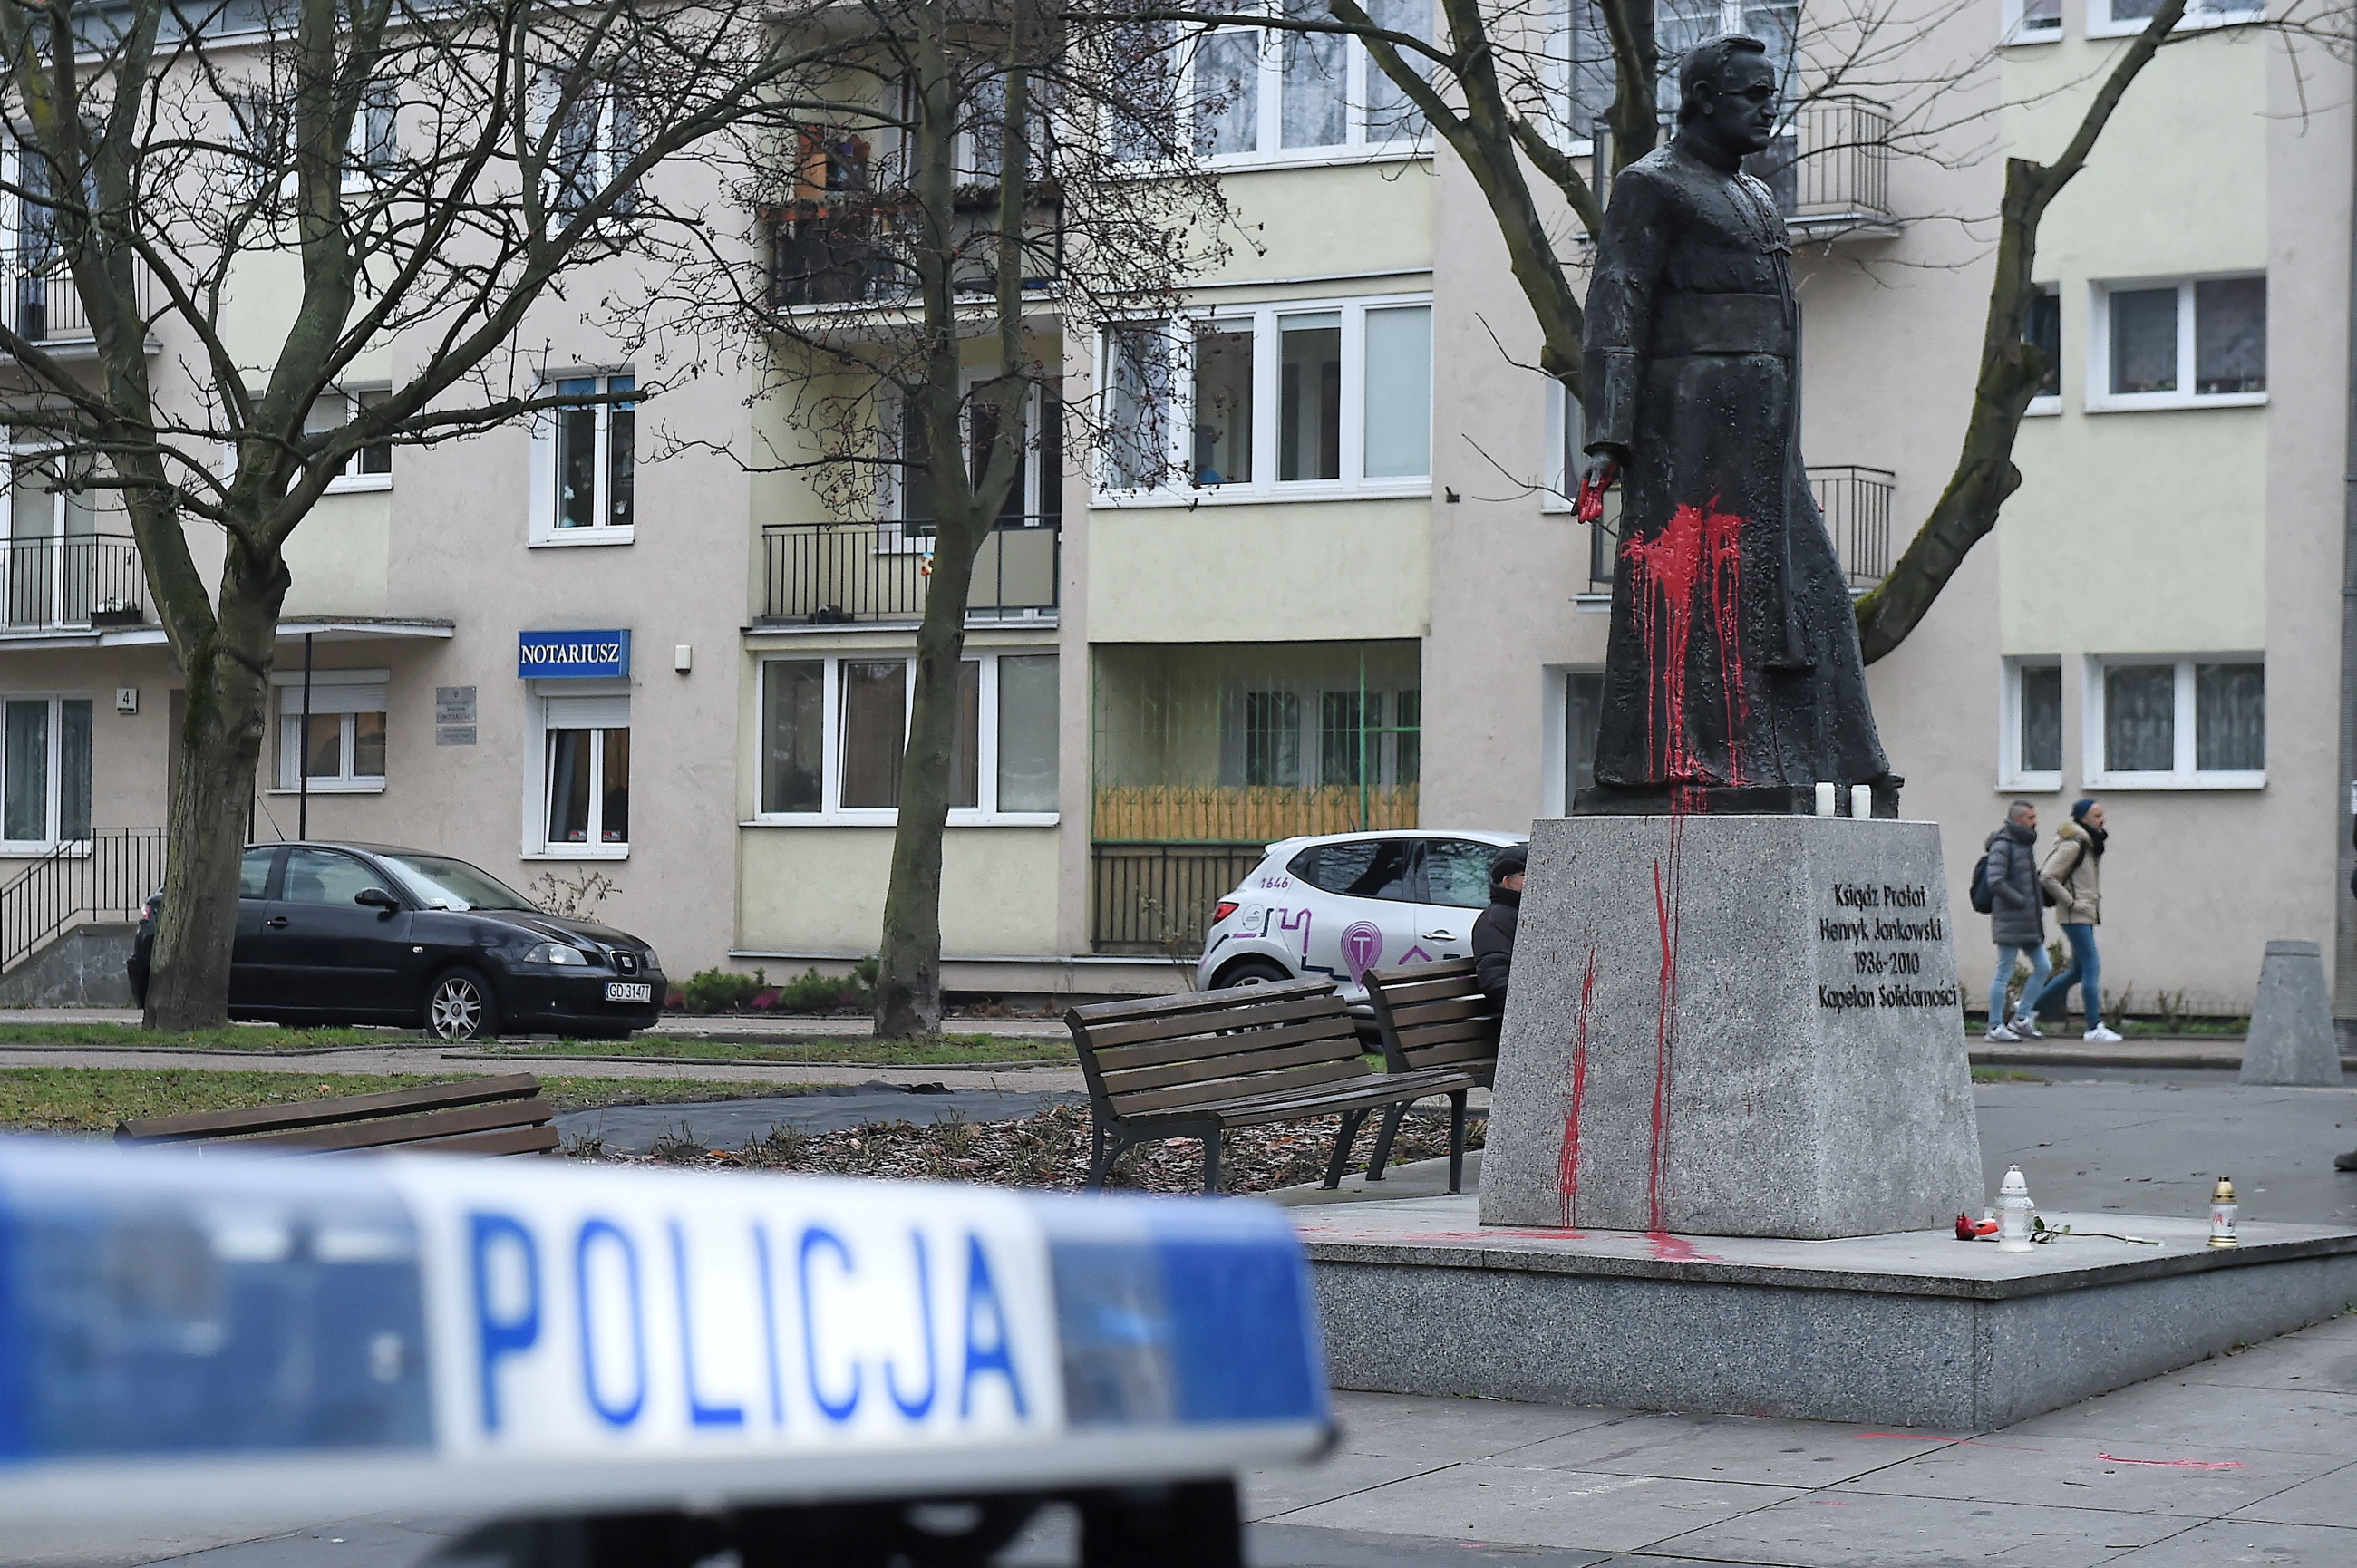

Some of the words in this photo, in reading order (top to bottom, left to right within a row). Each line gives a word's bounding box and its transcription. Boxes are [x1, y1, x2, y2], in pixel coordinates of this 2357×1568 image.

[520, 644, 619, 664] NOTARIUSZ
[122, 690, 130, 705] 4
[1261, 876, 1288, 889] 1646
[1834, 884, 1879, 911] Ksiądz
[1819, 918, 1869, 945] Henryk
[1874, 918, 1942, 941] Jankowski
[1854, 952, 1920, 975] 1936-2010
[609, 984, 624, 998] GD
[1818, 984, 1875, 1014] Kapelan
[1878, 979, 1957, 1008] Solidarności
[467, 1209, 1030, 1432] POLICJA
